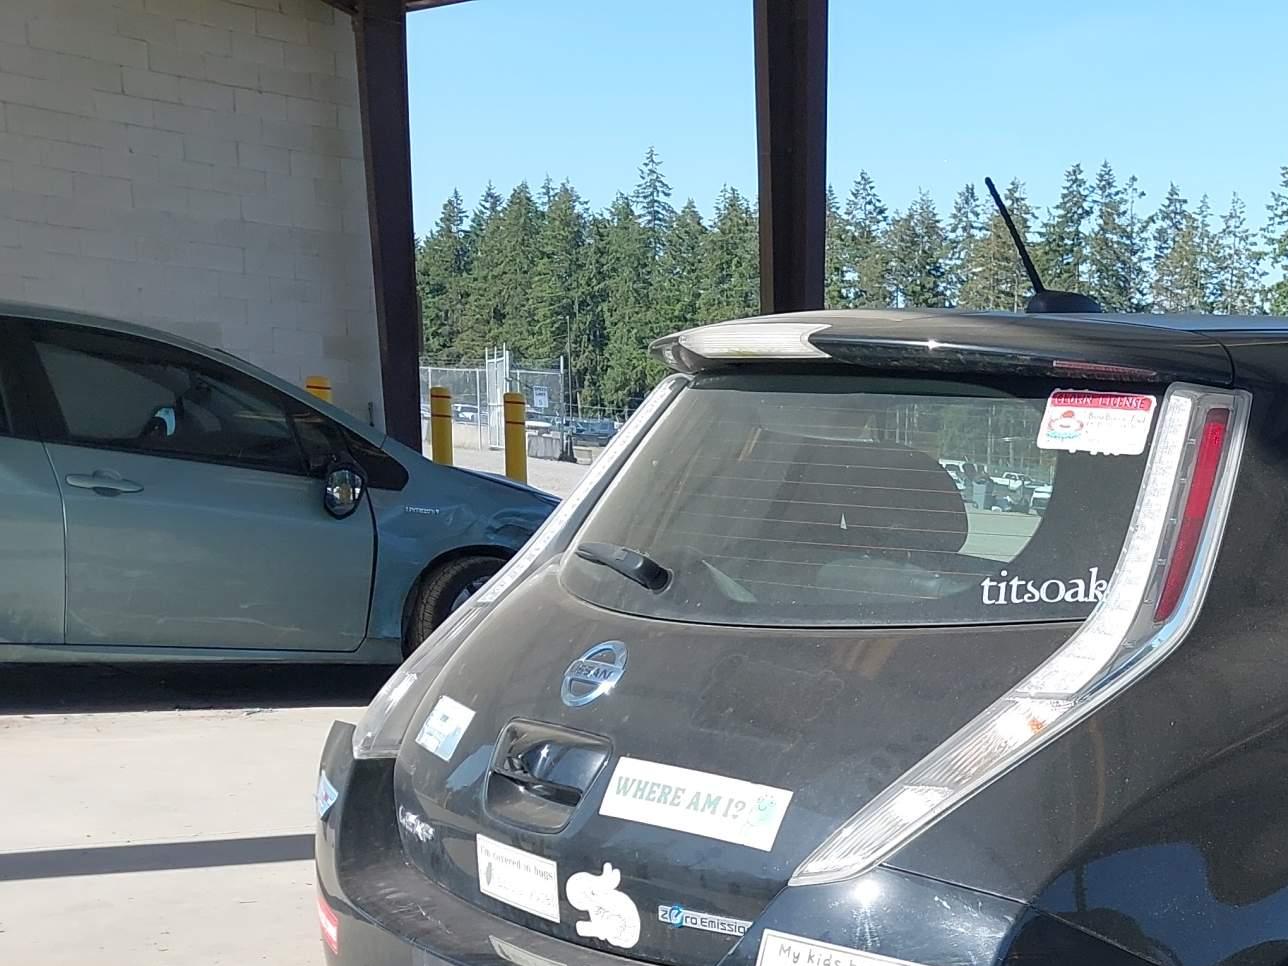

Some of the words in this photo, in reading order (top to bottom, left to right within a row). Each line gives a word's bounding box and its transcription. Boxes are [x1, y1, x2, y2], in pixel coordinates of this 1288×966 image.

[1098, 396, 1145, 409] LICENSE
[981, 567, 1108, 605] titsoak
[615, 776, 687, 807] WHERE
[686, 791, 722, 816] AM
[722, 797, 747, 820] I?
[492, 851, 521, 870] covered
[533, 865, 554, 881] bugs
[700, 918, 747, 935] Emissio
[778, 943, 800, 964] My
